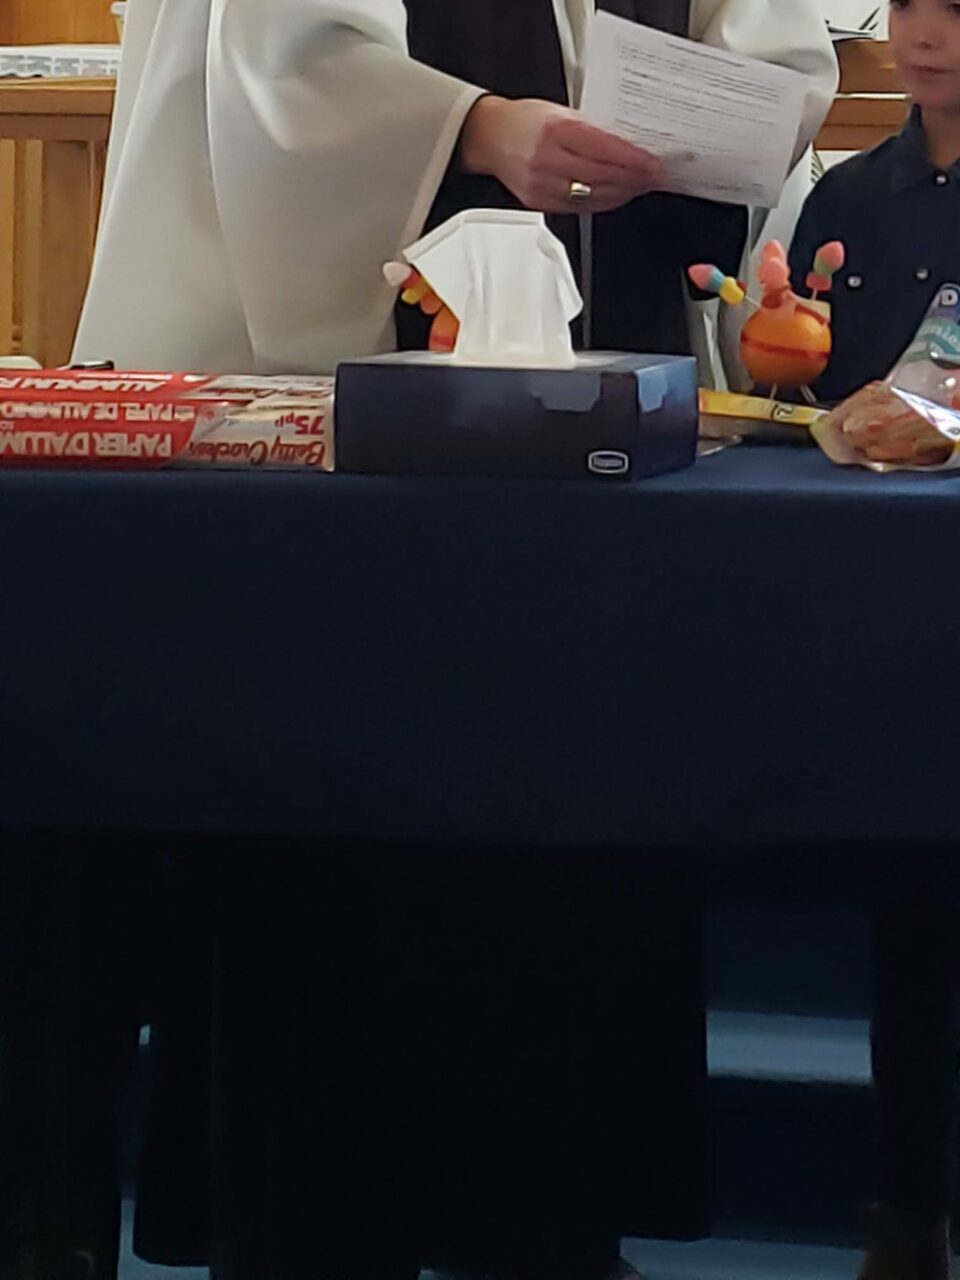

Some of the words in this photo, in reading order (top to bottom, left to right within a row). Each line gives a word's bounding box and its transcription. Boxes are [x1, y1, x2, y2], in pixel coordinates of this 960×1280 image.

[93, 402, 119, 420] DE
[120, 402, 173, 421] PAPEL
[92, 432, 172, 458] PAPIER
[270, 435, 326, 466] Betty
